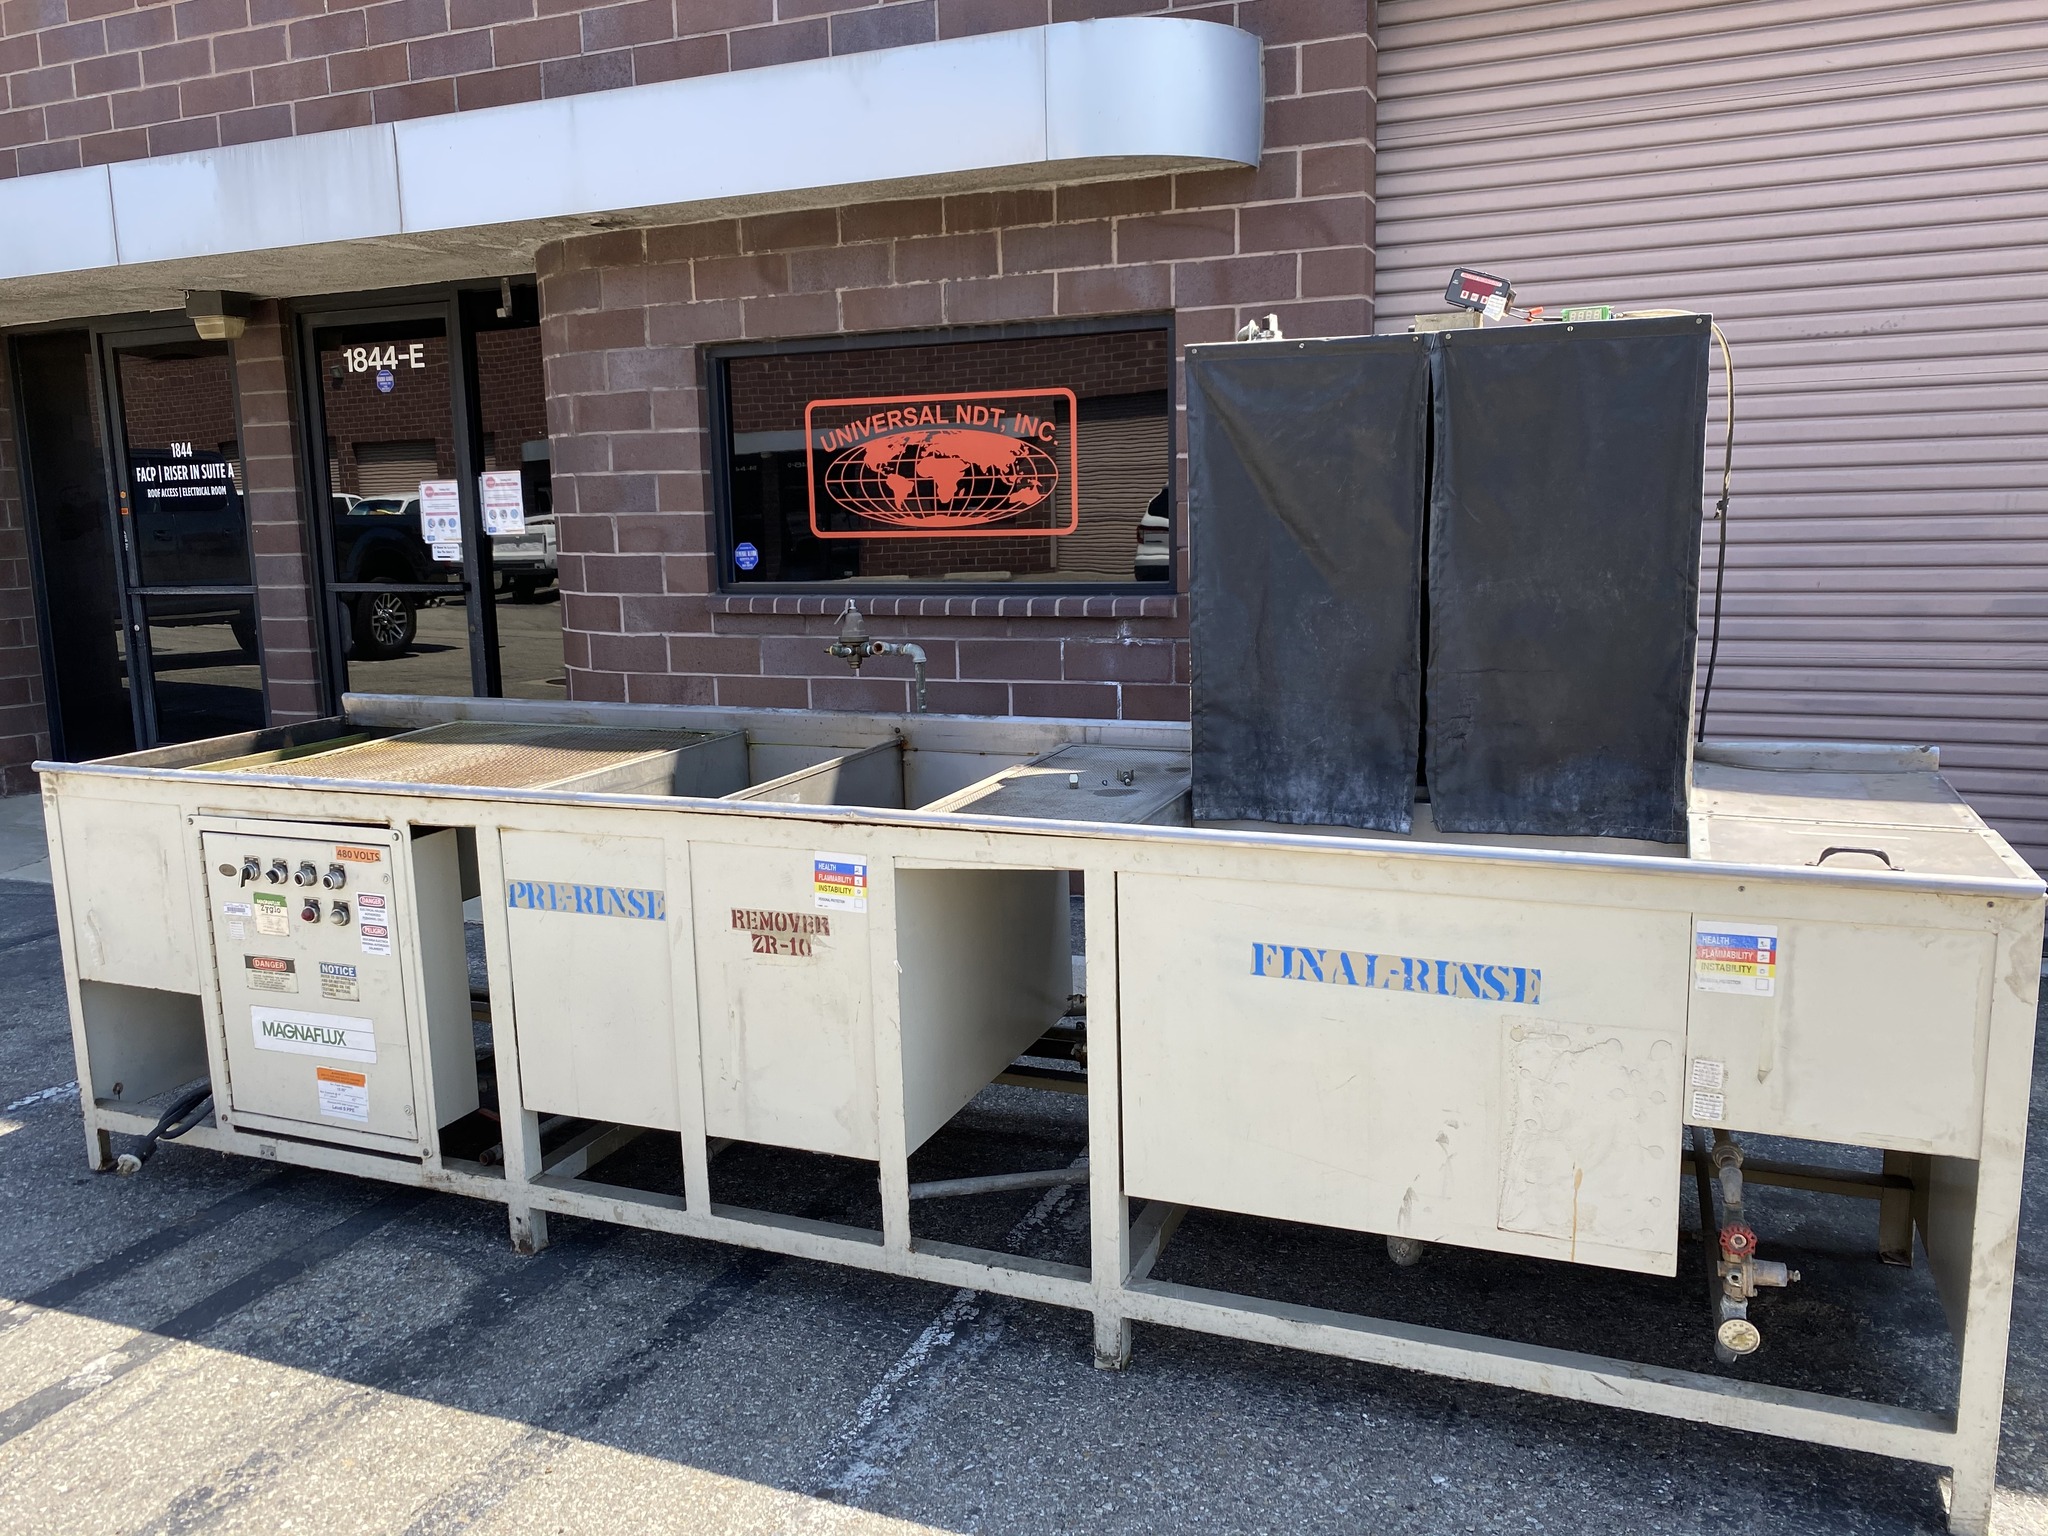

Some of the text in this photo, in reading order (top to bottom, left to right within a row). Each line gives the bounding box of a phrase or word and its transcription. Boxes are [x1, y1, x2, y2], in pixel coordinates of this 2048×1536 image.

[343, 344, 425, 373] 1844-E
[820, 404, 1060, 452] UNIVERSAL NDT, INC.
[170, 442, 193, 458] 1844
[136, 466, 156, 482] FACP
[163, 465, 188, 481] RISER
[190, 464, 200, 480] IN
[201, 463, 227, 479] SUITE
[228, 462, 235, 478] A
[147, 488, 161, 498] ROOF
[161, 487, 179, 498] ACCESS
[182, 486, 210, 497] ELECTRICAL
[210, 485, 227, 496] ROOM
[337, 850, 380, 861] 480 VOLTS
[818, 863, 837, 871] HEALTH
[818, 873, 853, 884] FLAMMABILITY
[818, 884, 852, 895] INSTABILITY
[508, 881, 667, 921] PRE-RINSE
[731, 909, 831, 936] REMOVER
[751, 933, 812, 957] ZR-10
[1702, 935, 1730, 945] HEALTH
[1701, 948, 1755, 961] FLAMMABILITY
[255, 960, 285, 969] DANGER
[322, 963, 355, 977] NOTICE
[1701, 962, 1753, 974] INSTABILITY
[1251, 942, 1541, 1004] FINAL-RINSE
[262, 1020, 347, 1047] MAGNAFLUX
